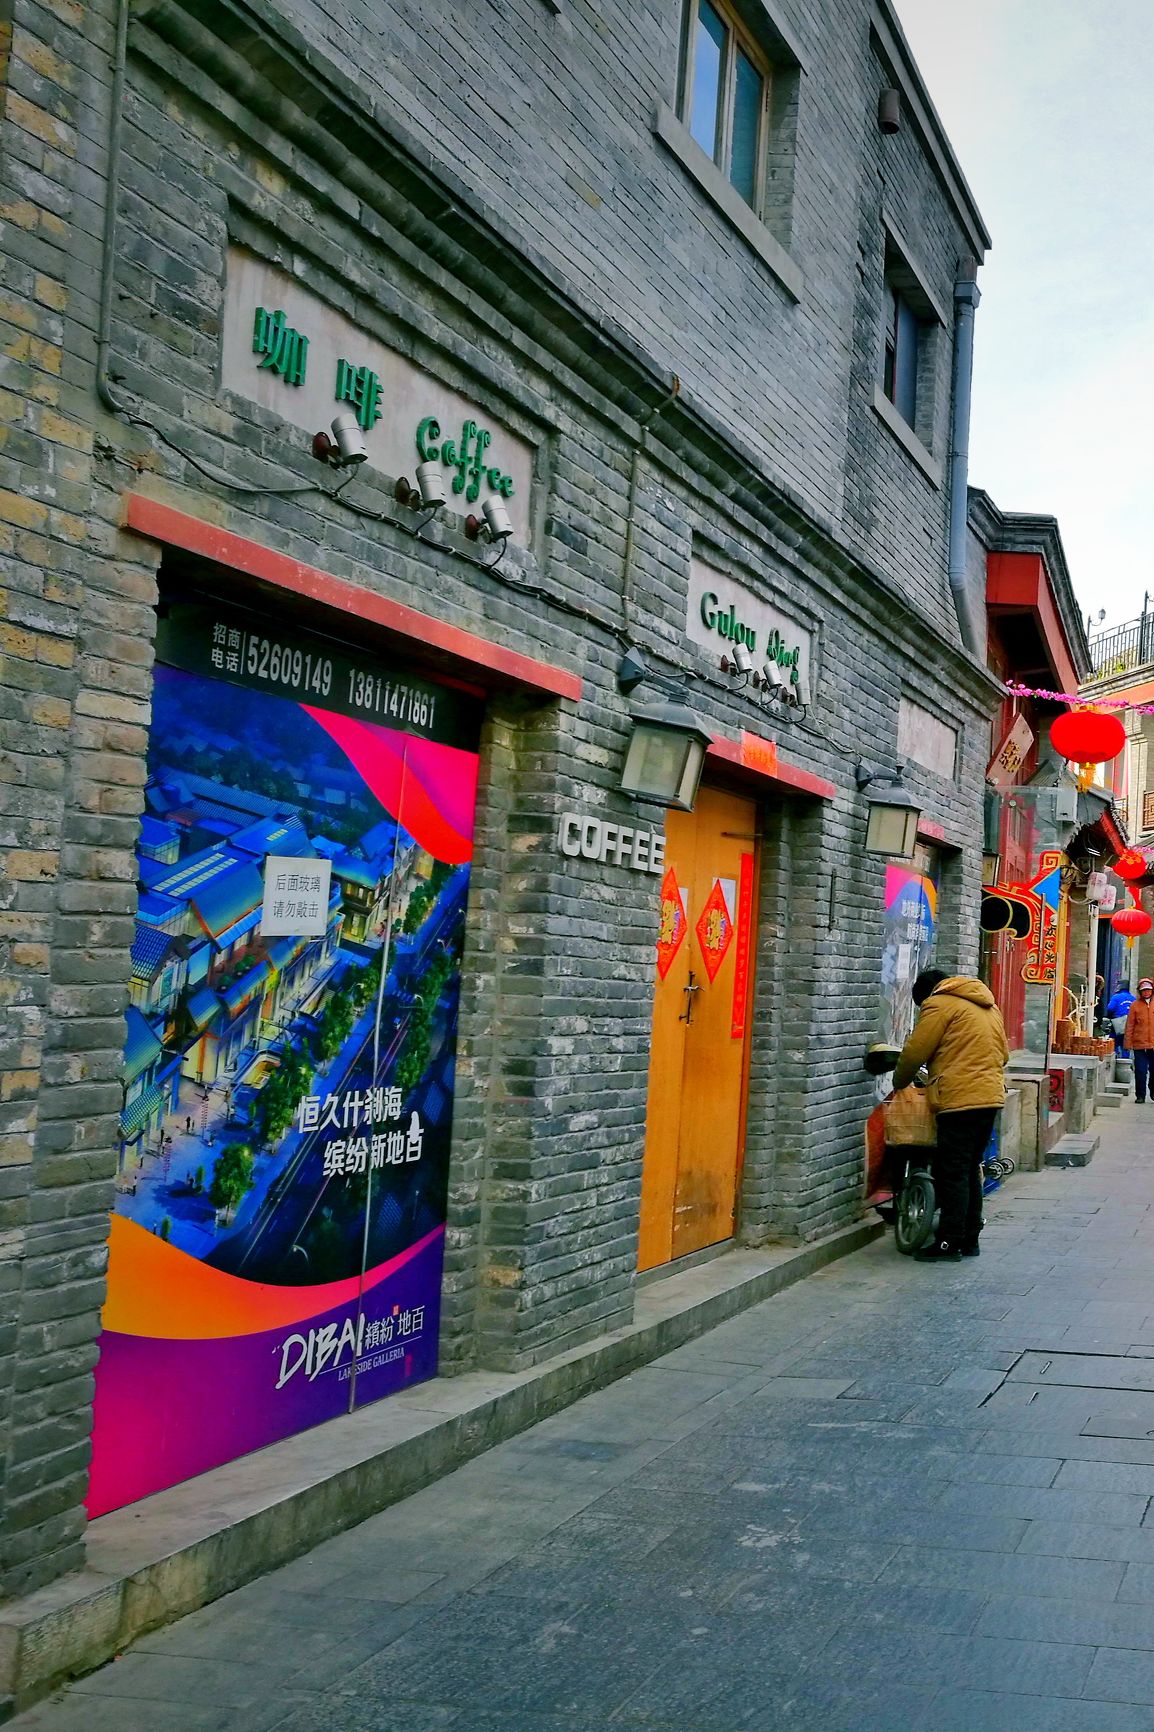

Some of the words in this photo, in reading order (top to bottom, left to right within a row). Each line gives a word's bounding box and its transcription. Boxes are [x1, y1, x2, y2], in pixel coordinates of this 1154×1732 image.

[253, 306, 384, 430] 咖啡
[416, 416, 515, 502] Coffee
[212, 622, 241, 650] 招商
[700, 592, 756, 653] Gulou
[211, 647, 239, 673] 电话
[248, 635, 333, 697] 52609149
[349, 668, 436, 729] 13811471861
[560, 811, 667, 874] COFFEE
[273, 900, 319, 918] 请勿敲击
[275, 873, 321, 893] 后面玻璃
[298, 1086, 403, 1134] 恒久什刹海
[322, 1114, 424, 1178] 缤纷新地百
[275, 1312, 366, 1389] DIBAI
[337, 1359, 373, 1382] LAKSIDE
[372, 1346, 405, 1369] GALLERIA
